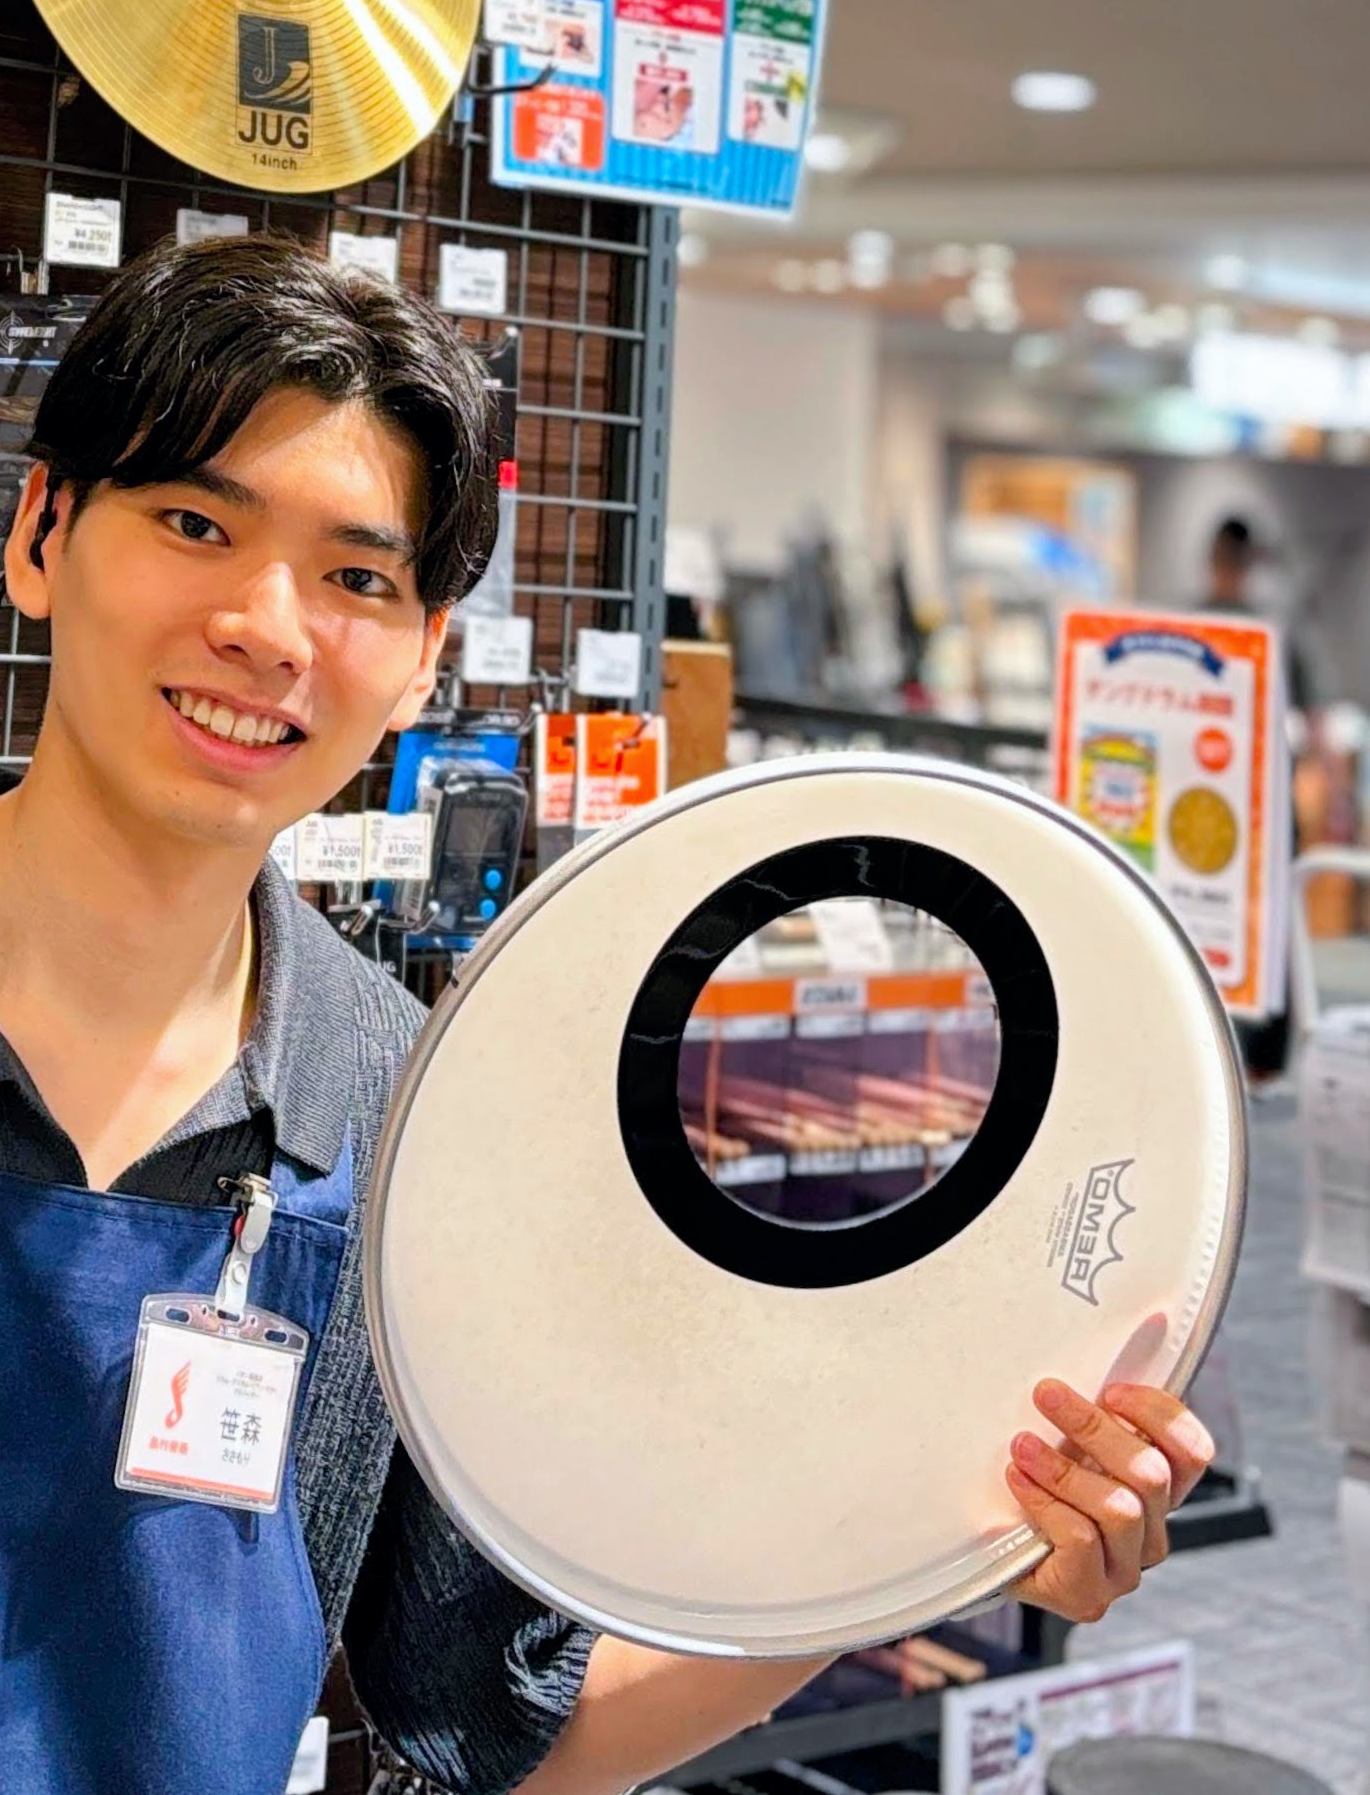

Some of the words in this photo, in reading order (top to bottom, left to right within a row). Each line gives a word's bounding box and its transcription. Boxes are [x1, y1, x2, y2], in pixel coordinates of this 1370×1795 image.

[238, 110, 310, 149] JUG
[251, 152, 298, 171] 14inch
[220, 1408, 262, 1445] 笹森
